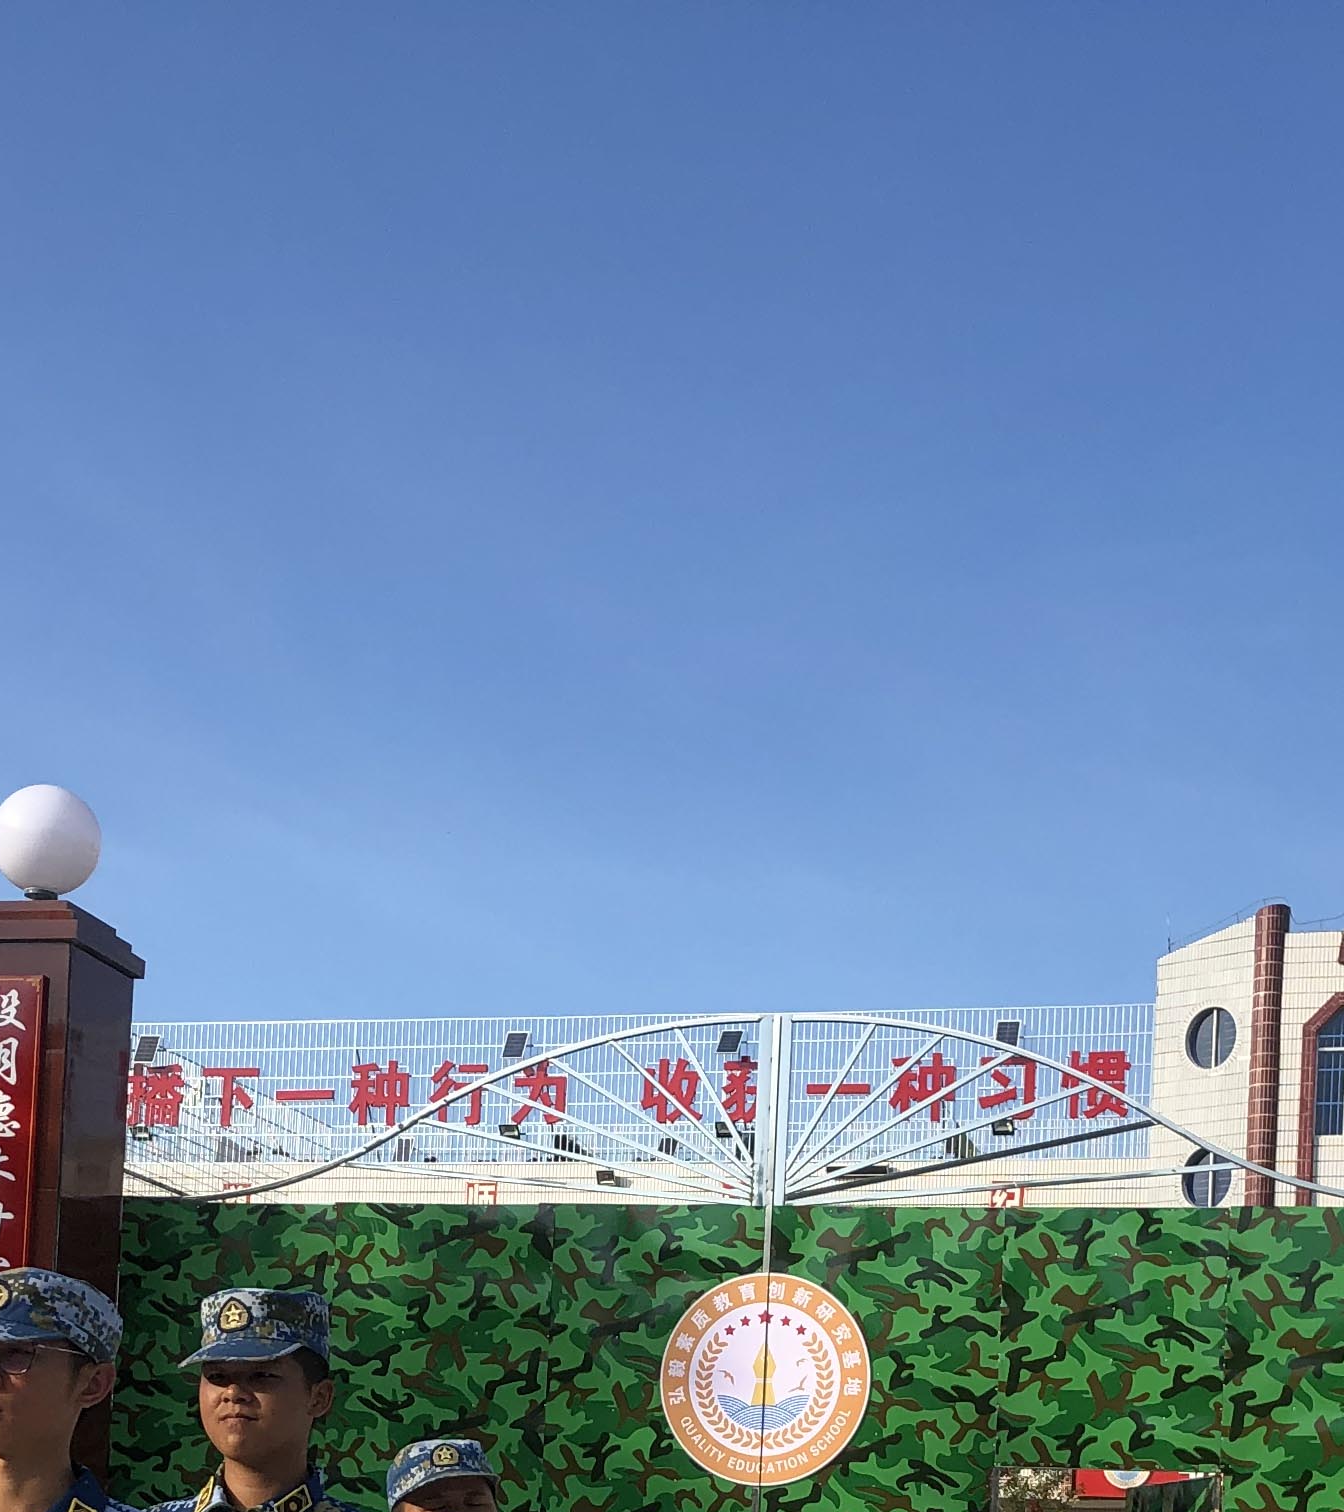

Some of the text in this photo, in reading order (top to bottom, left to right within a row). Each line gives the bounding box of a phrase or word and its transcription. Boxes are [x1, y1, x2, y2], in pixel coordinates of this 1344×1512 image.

[128, 1060, 567, 1127] 播下一种行为
[668, 1282, 863, 1405] 弘毅素质教育创新研究基地
[681, 1408, 852, 1474] QUALITY EDUCATION SCHOOL
